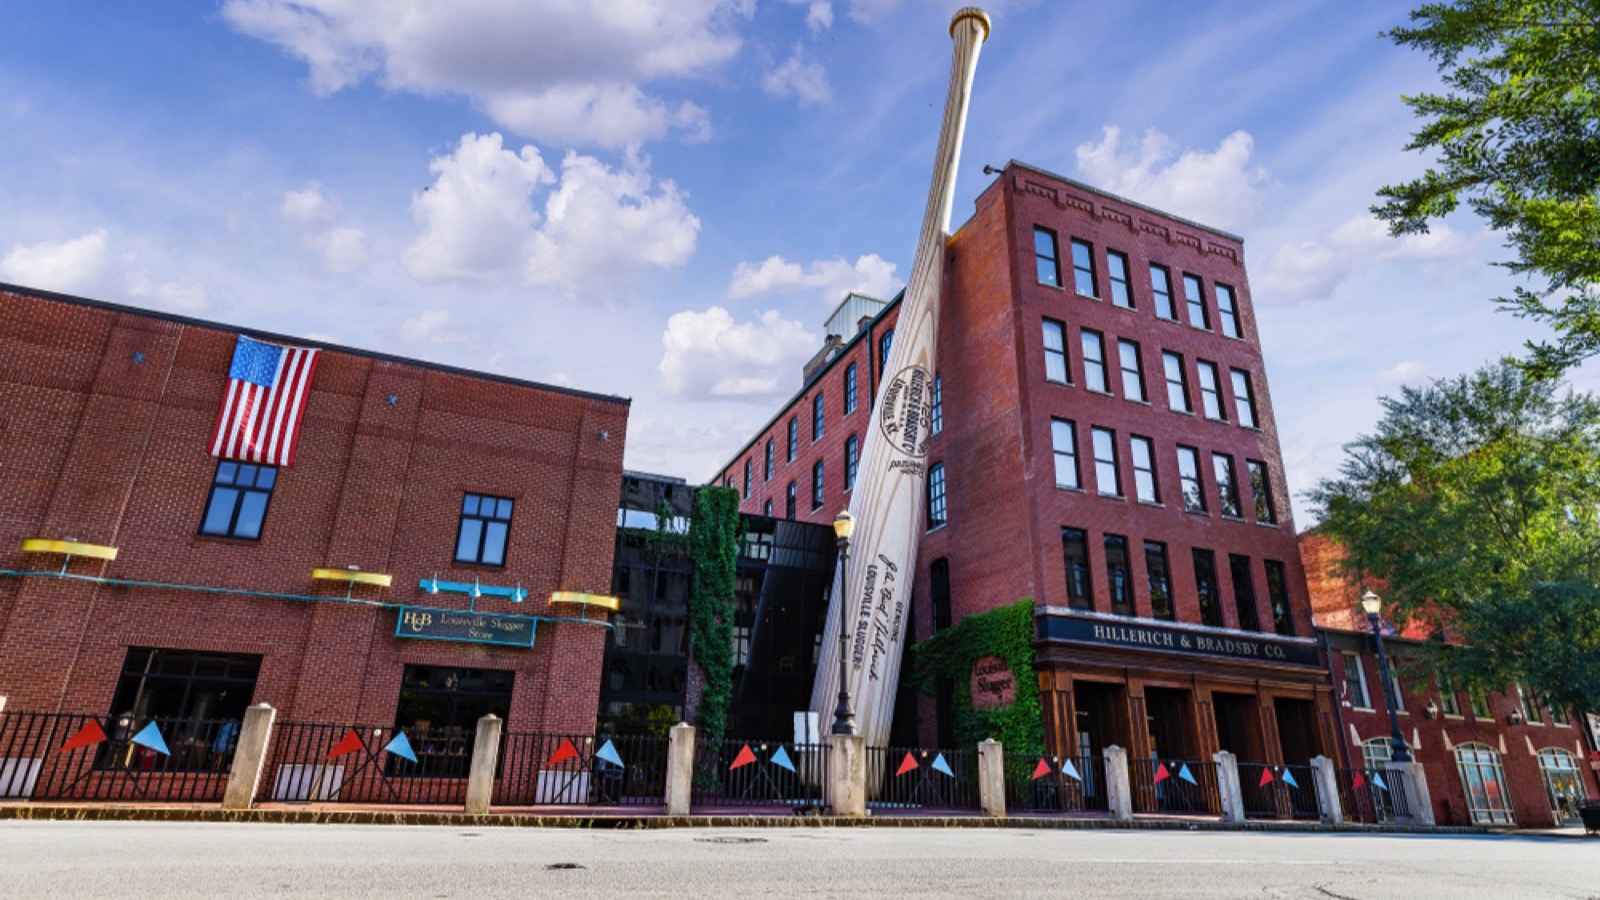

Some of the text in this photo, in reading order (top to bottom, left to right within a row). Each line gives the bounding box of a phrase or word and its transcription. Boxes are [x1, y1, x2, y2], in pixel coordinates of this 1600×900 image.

[860, 564, 878, 618] LOUISVILLE
[441, 613, 525, 632] Louisville Slugger
[1093, 625, 1174, 647] HILLERICH
[1180, 635, 1191, 648] &
[1196, 637, 1259, 656] BRADSBY
